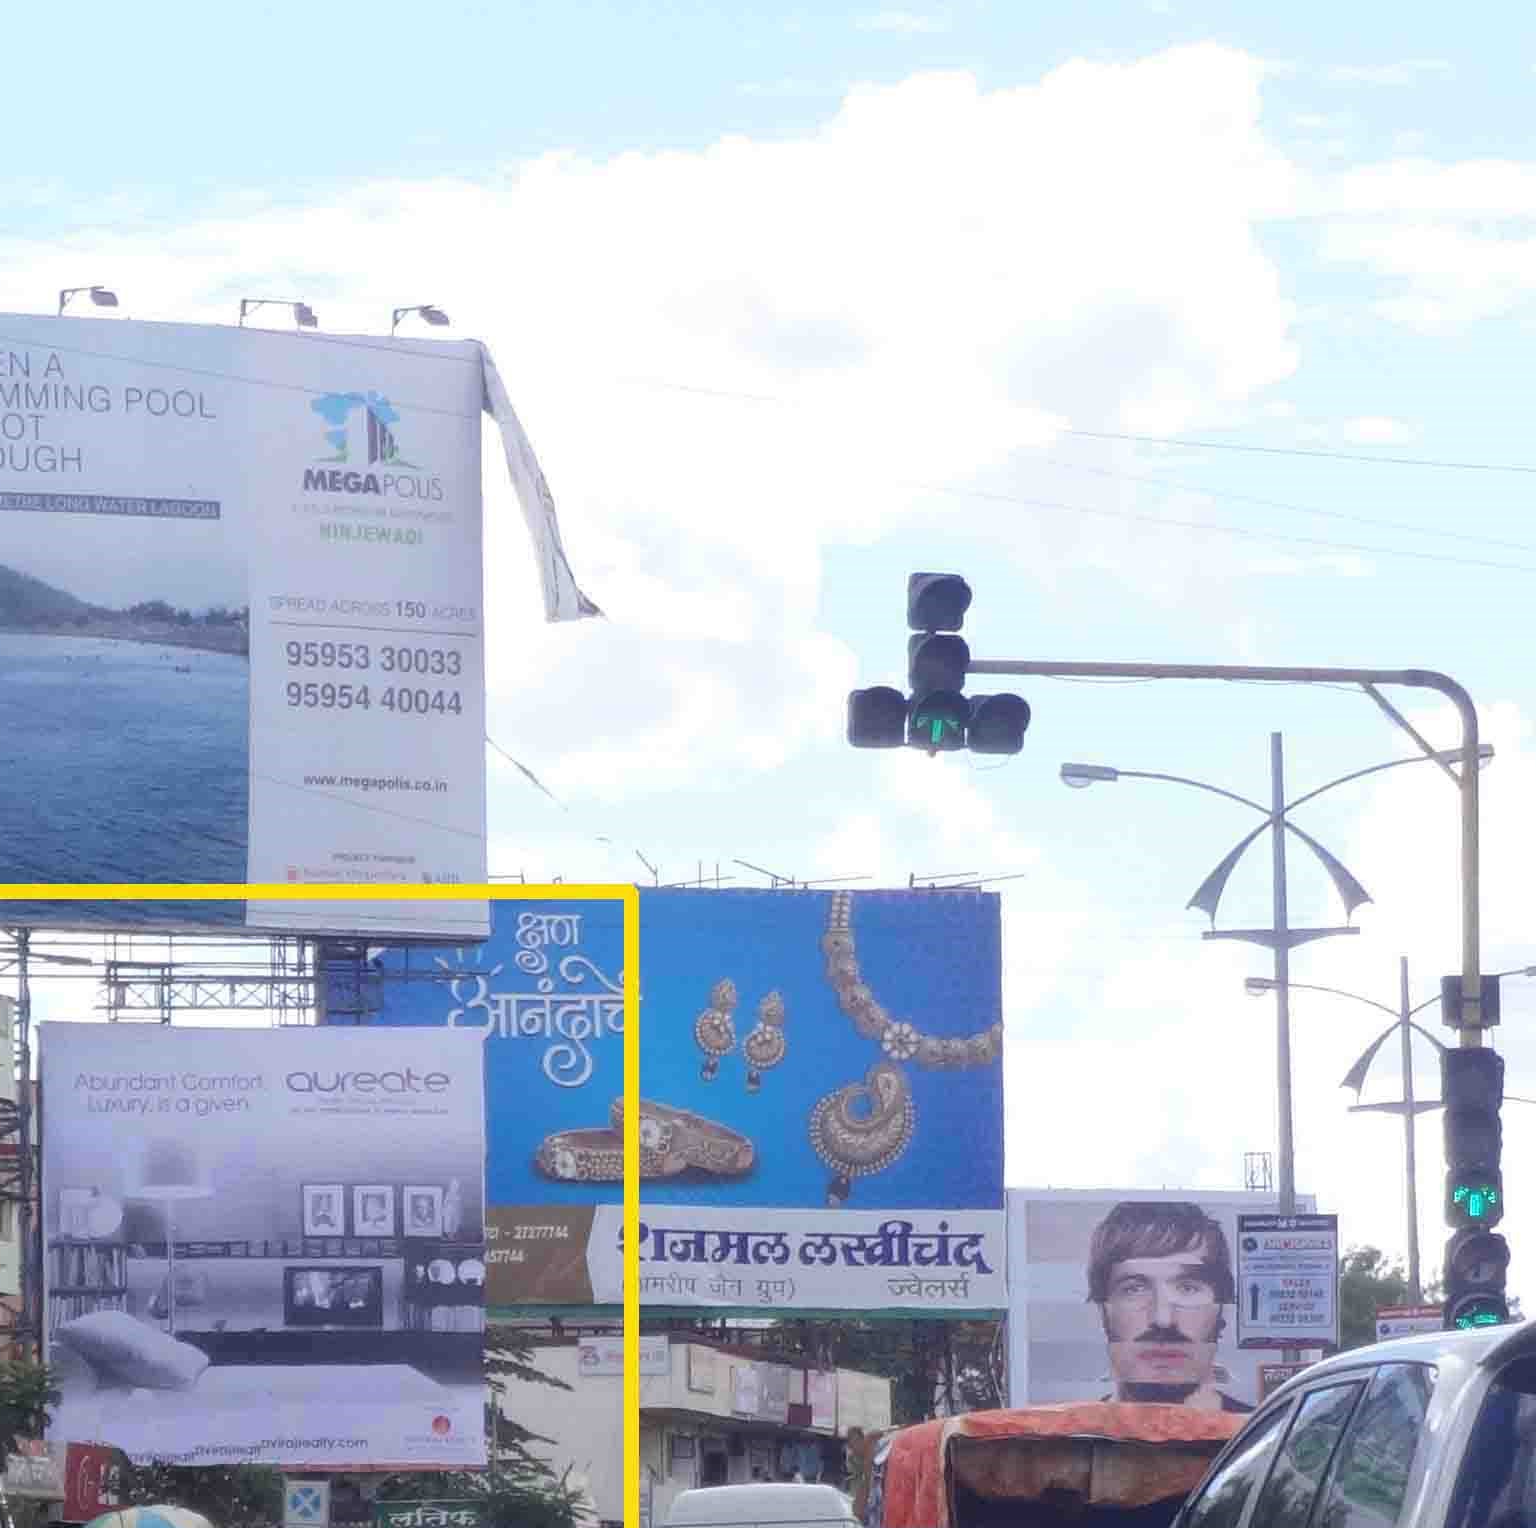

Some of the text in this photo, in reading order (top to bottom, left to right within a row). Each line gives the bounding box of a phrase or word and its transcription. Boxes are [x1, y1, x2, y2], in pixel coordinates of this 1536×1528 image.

[43, 351, 65, 377] A
[124, 386, 217, 419] POOL
[395, 601, 426, 619] 150
[284, 640, 463, 677] 95953 30033
[285, 681, 463, 716] 95954 40044
[302, 774, 449, 794] www.megapolis.co.in
[73, 1071, 178, 1093] Abundant
[285, 1067, 451, 1095] aureate
